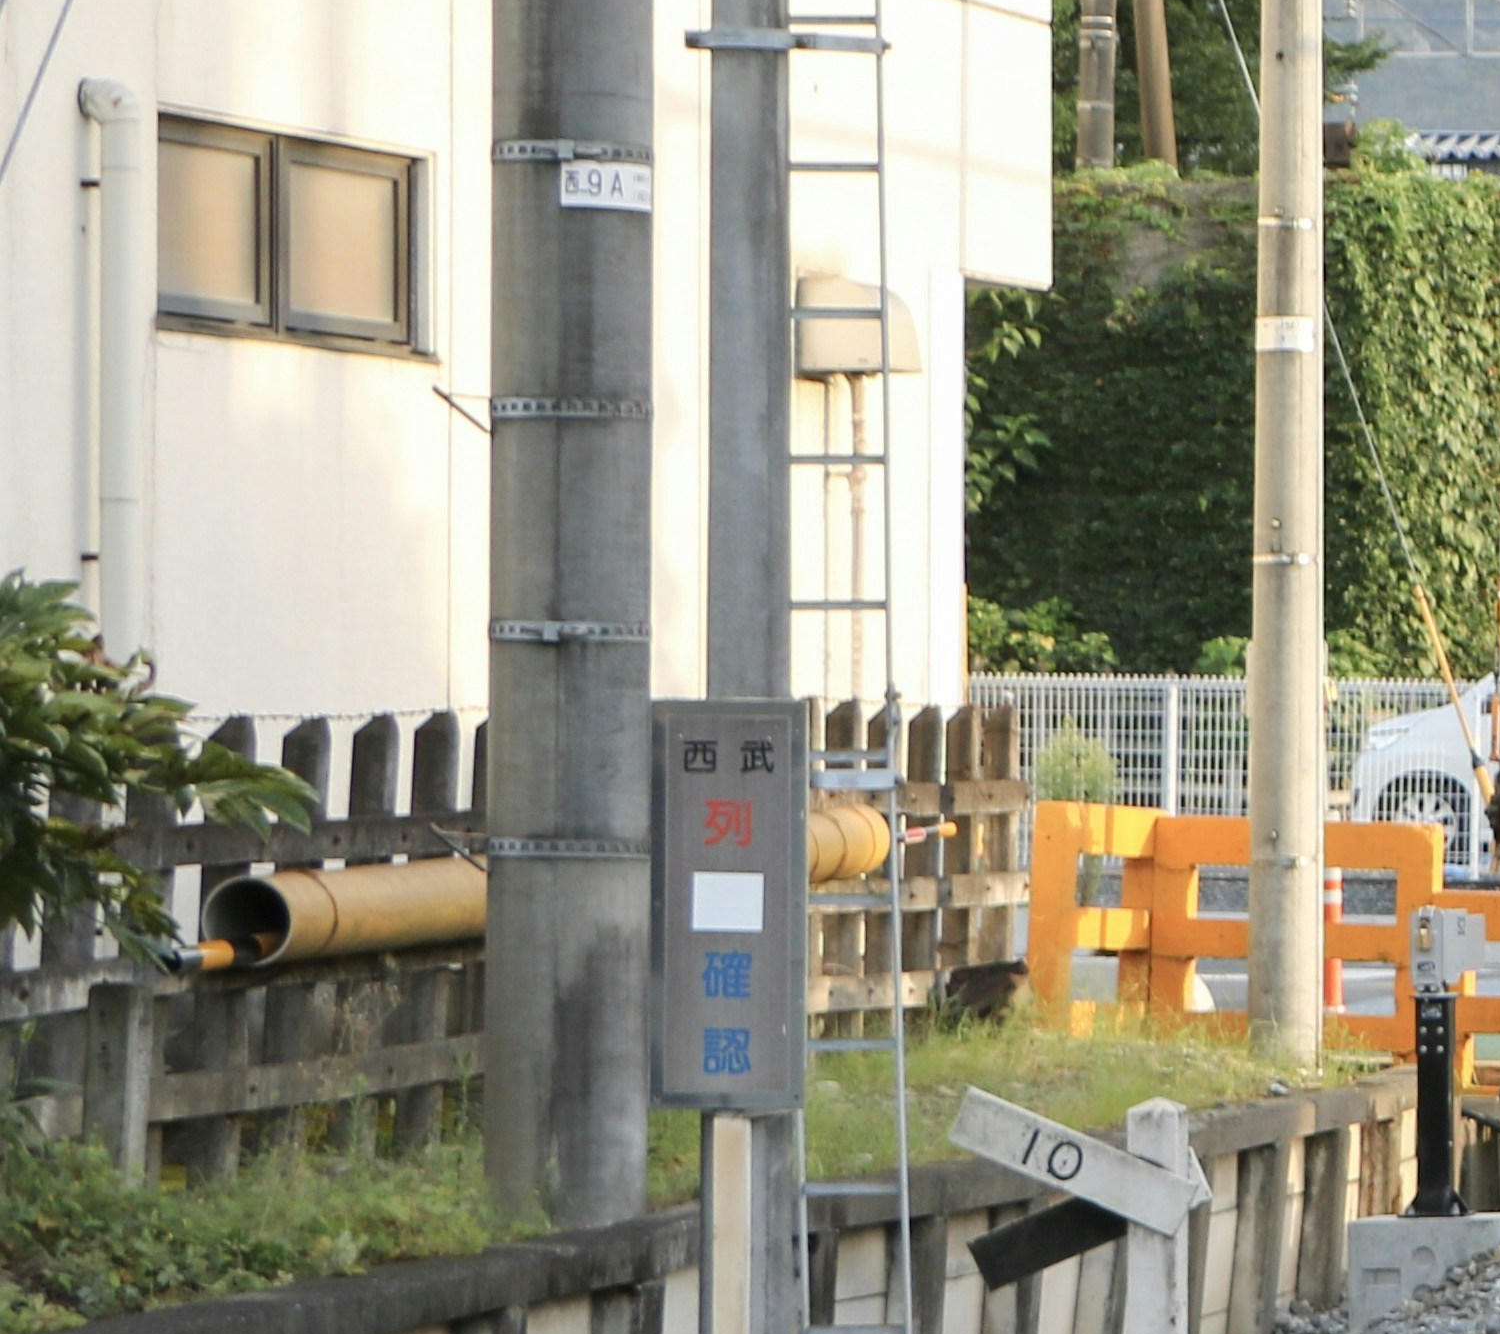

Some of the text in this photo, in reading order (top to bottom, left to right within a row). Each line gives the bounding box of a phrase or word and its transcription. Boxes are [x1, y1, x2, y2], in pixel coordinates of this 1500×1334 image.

[683, 739, 775, 774] 西武
[702, 799, 753, 1075] 列 確認
[1021, 1128, 1083, 1181] 10
